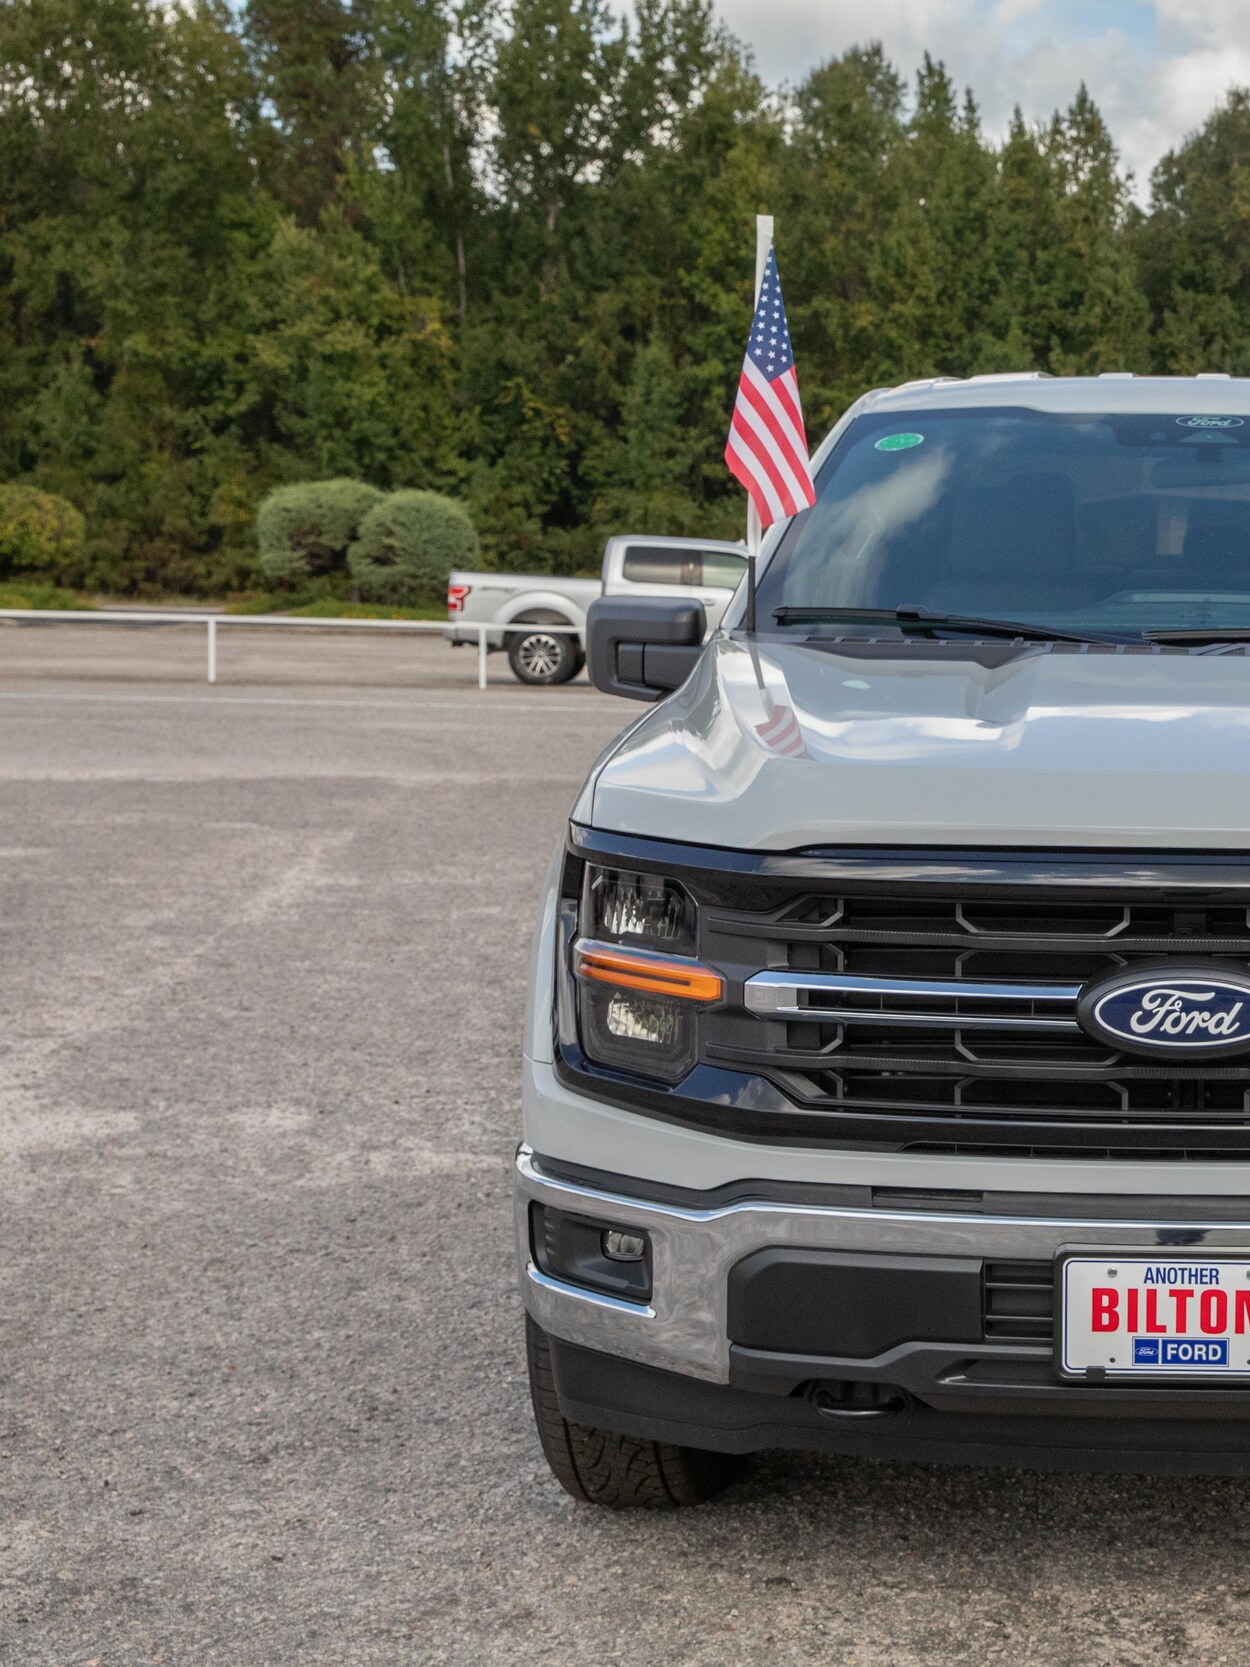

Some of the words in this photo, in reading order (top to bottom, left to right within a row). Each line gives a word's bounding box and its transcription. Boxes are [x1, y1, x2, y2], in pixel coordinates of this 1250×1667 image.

[1187, 416, 1232, 427] Ford
[1130, 989, 1244, 1035] Ford
[1143, 1267, 1220, 1286] ANOTHER
[1137, 1347, 1155, 1356] Ford
[1166, 1343, 1222, 1361] FORD
